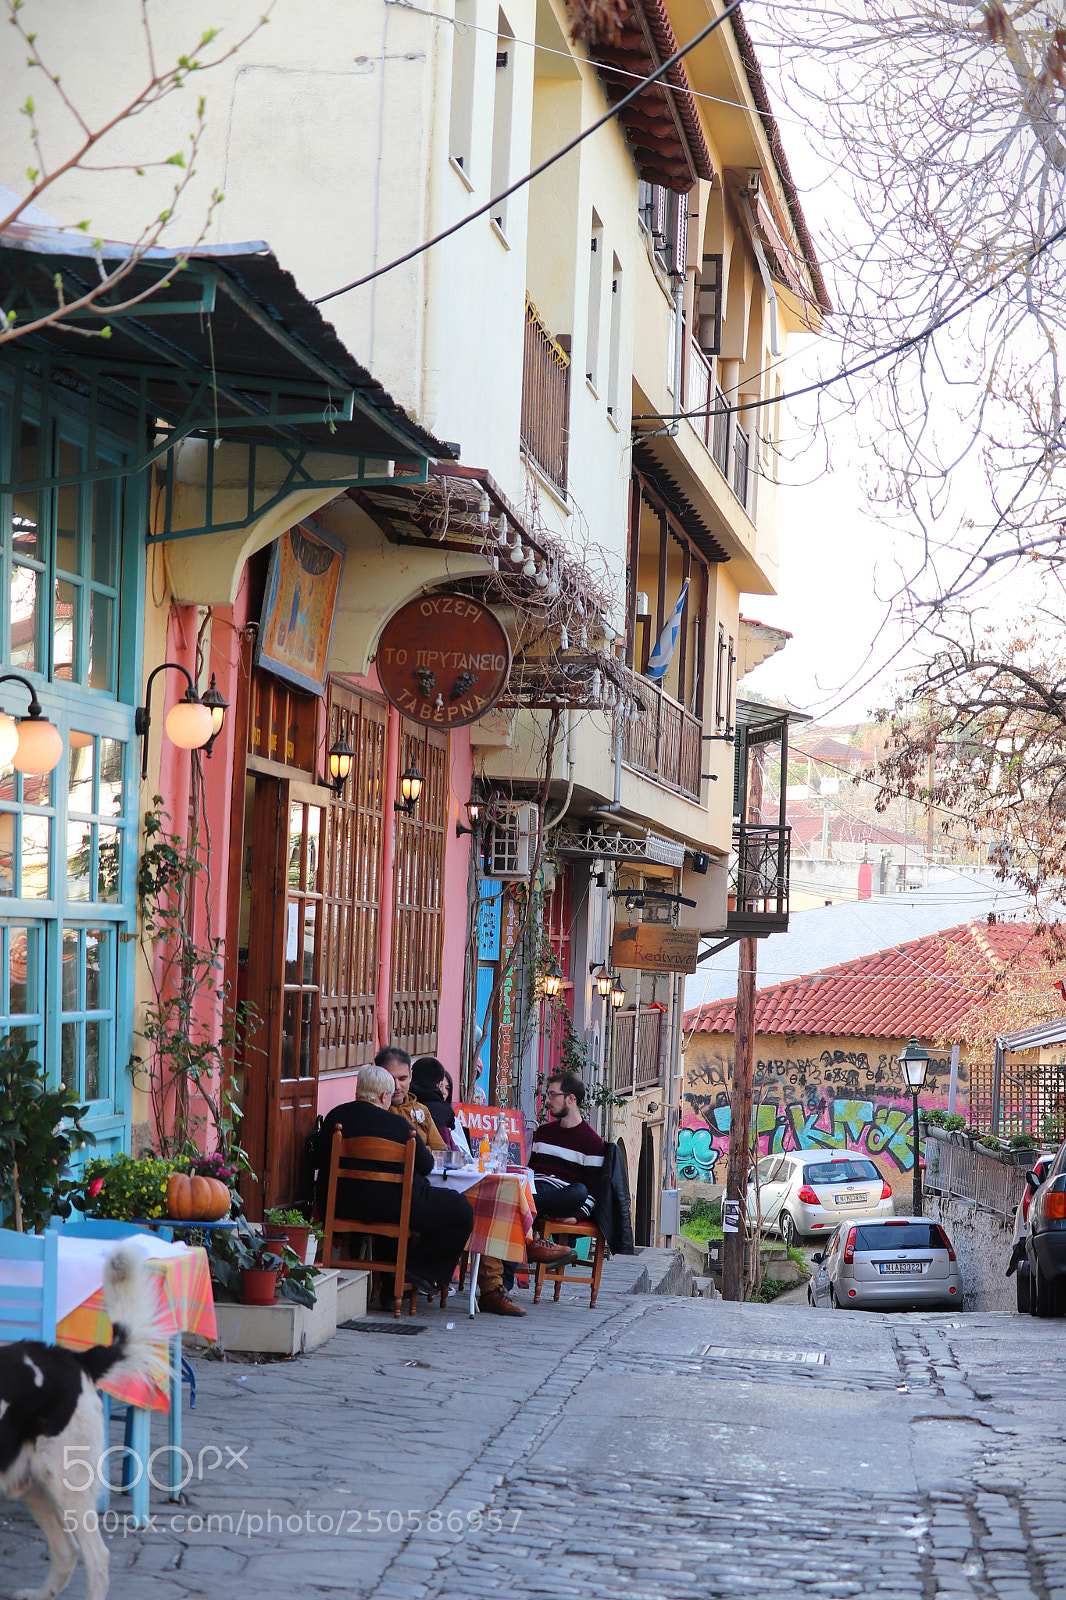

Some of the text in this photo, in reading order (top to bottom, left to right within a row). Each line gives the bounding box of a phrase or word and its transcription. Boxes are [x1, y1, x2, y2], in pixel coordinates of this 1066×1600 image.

[385, 648, 506, 672] ΤΟ ΠΡΥΤΑΝΕΙΟ
[396, 688, 487, 722] ΤΑΒΕΡΝΑ
[634, 945, 694, 964] Rediviva
